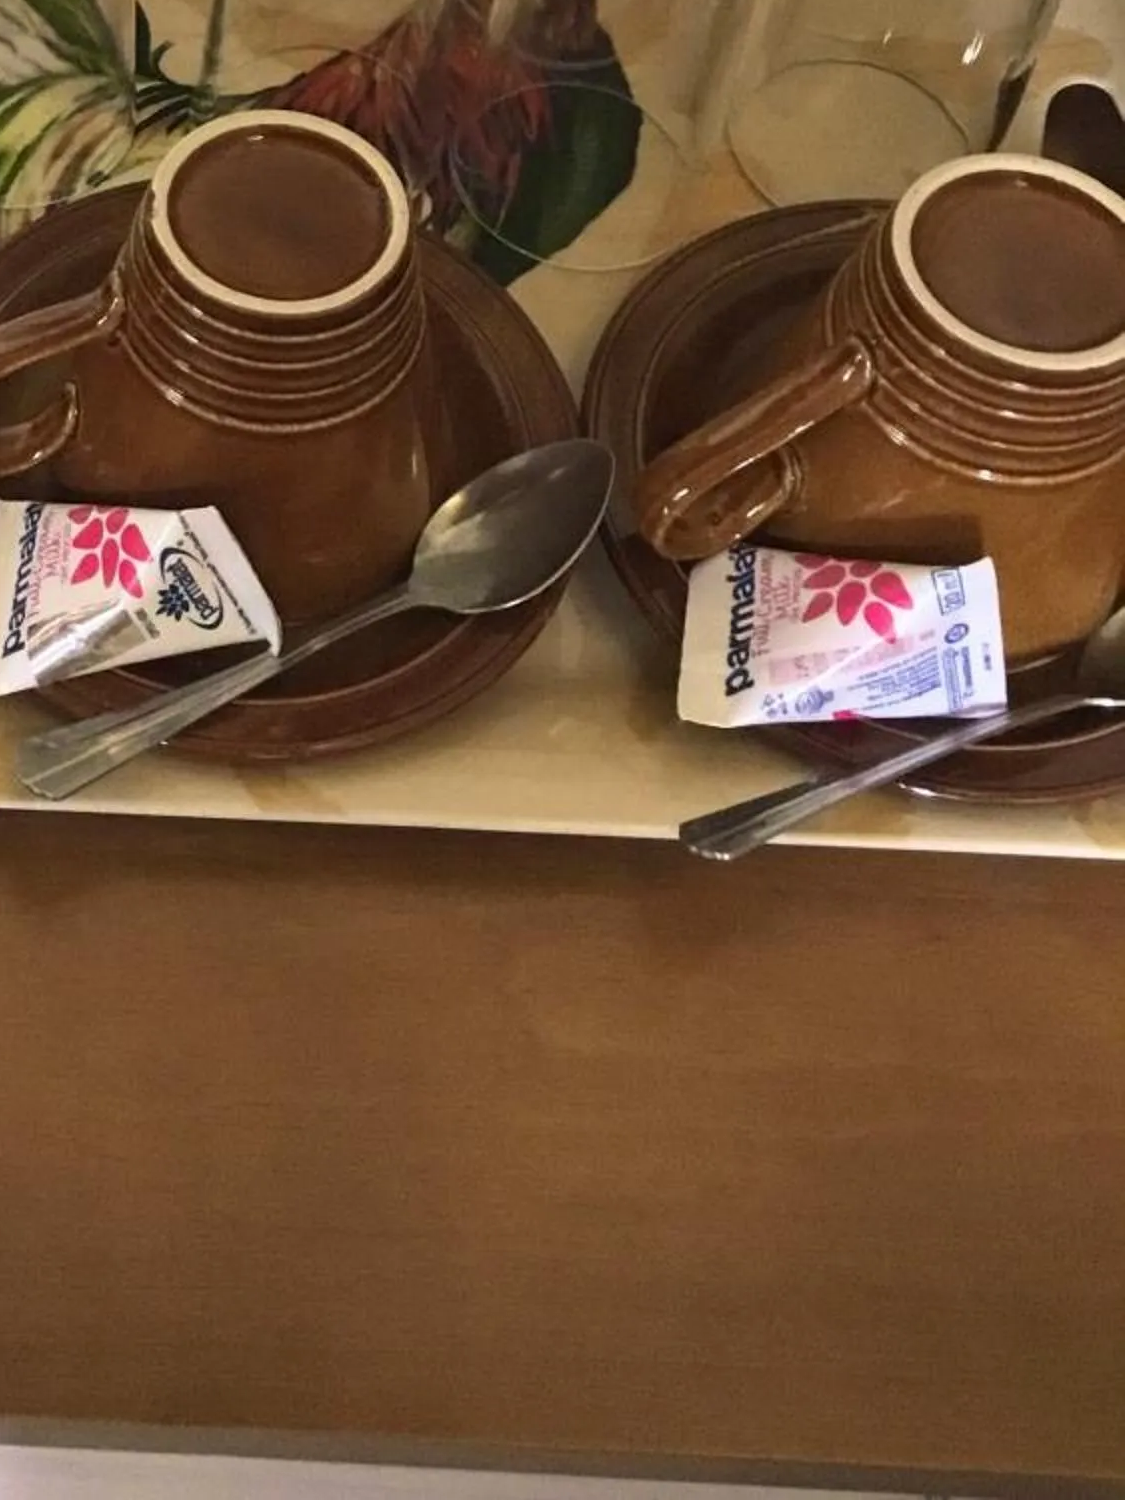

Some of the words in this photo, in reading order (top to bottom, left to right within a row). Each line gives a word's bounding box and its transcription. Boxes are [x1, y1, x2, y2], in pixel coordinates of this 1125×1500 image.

[1, 502, 44, 658] parmala
[166, 557, 218, 621] parmalat
[725, 546, 757, 697] parmala
